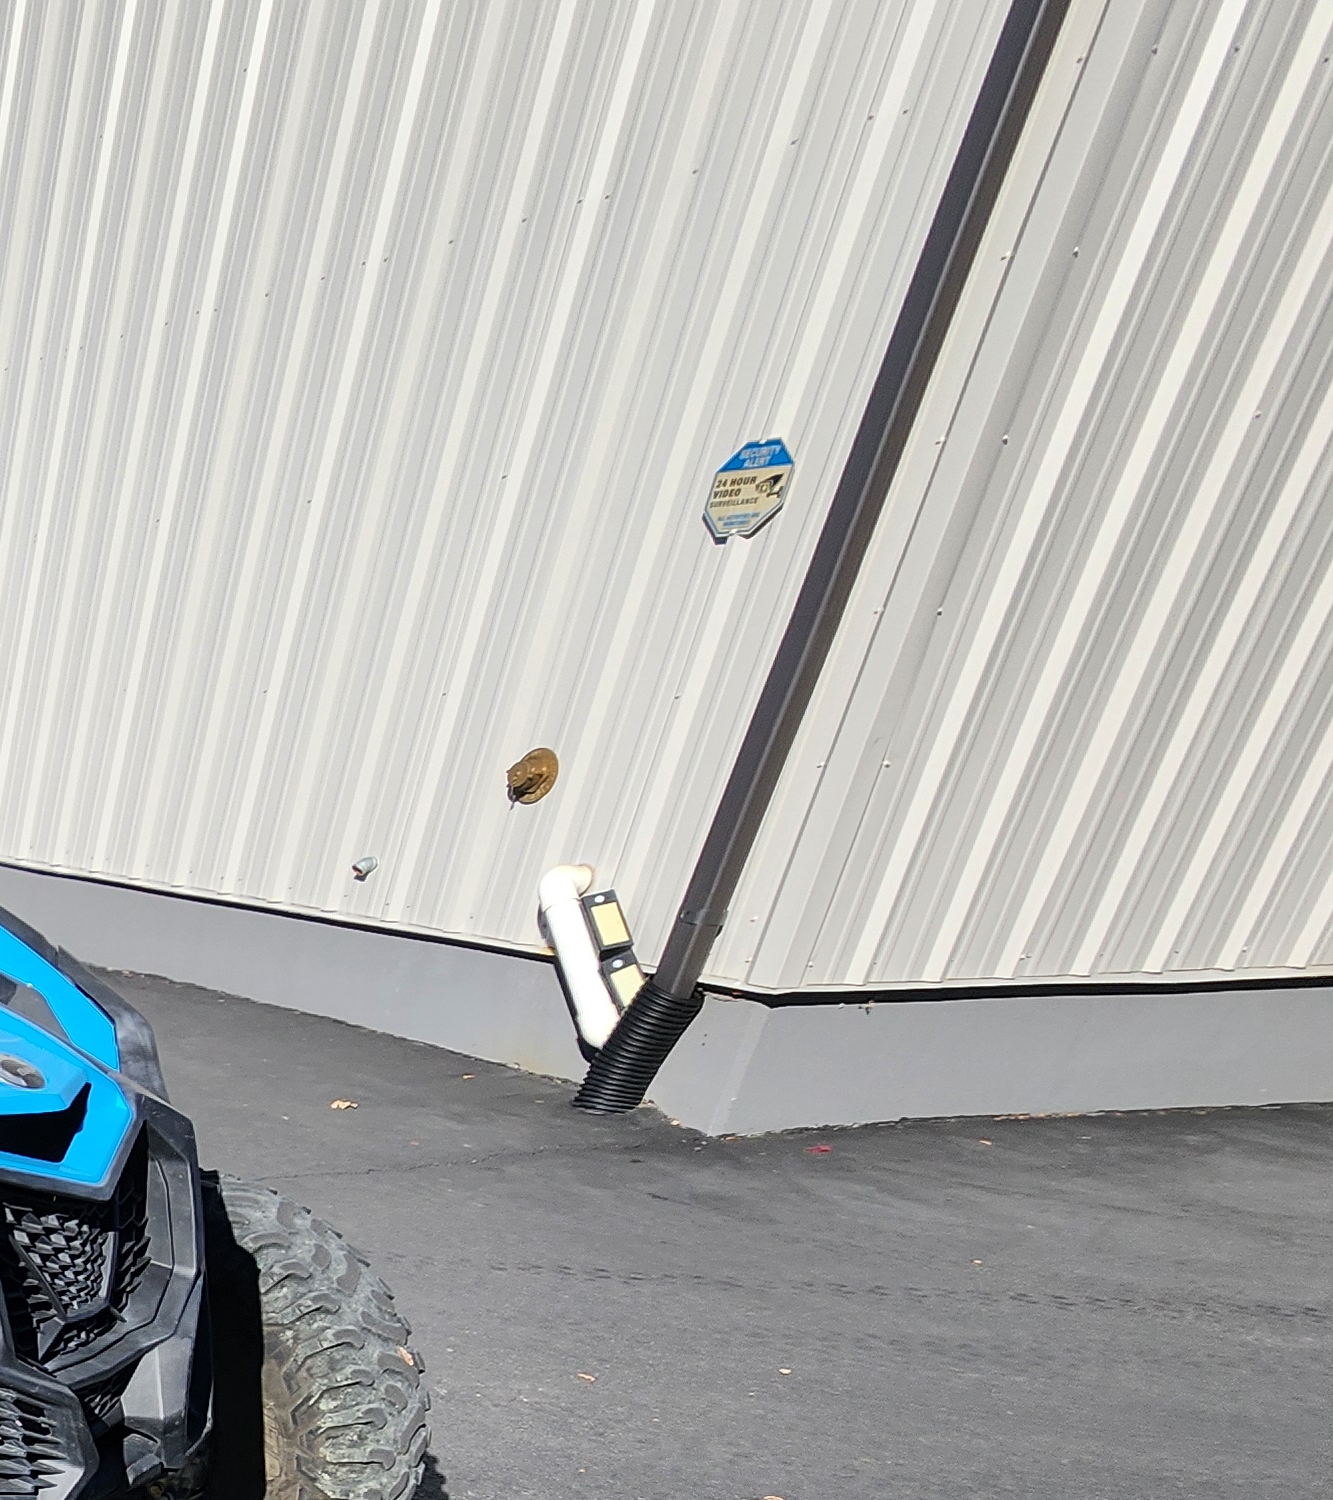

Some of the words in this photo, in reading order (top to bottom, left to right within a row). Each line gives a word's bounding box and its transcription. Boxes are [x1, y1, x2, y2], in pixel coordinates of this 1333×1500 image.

[715, 478, 728, 489] 24
[729, 476, 758, 487] HOUR
[712, 488, 742, 499] VIDEO
[709, 497, 760, 508] SURVEILLANCE
